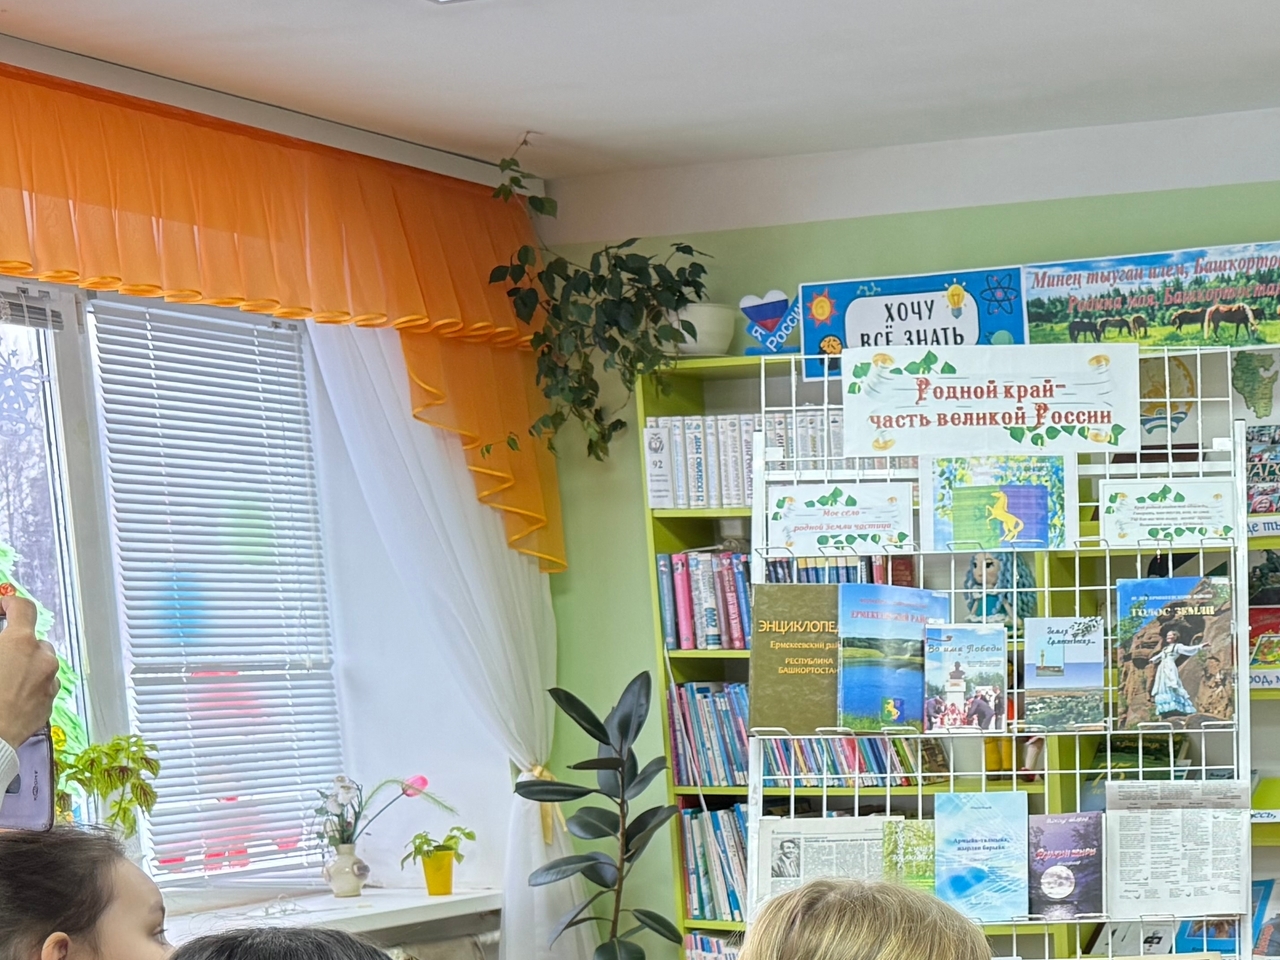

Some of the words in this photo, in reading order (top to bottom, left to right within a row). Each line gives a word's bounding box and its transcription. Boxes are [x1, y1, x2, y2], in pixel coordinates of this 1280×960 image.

[885, 300, 935, 323] ХОЧУ
[1067, 295, 1122, 314] Родина
[751, 325, 766, 342] Я
[861, 325, 893, 346] ВСЁ
[904, 327, 965, 346] ЗНАТЬ
[915, 377, 998, 405] Родной
[870, 413, 931, 429] часть
[937, 406, 1026, 426] великой
[1034, 402, 1112, 429] России
[652, 460, 663, 469] 92
[841, 509, 860, 517] село
[793, 523, 824, 533] родной
[853, 521, 892, 530] частица
[704, 607, 718, 628] 2000
[1132, 607, 1171, 617] ГОЛОС
[1174, 605, 1215, 616] ЗЕМЛИ
[966, 644, 1002, 653] Победы
[785, 657, 833, 665] РЕСПУБЛИКА
